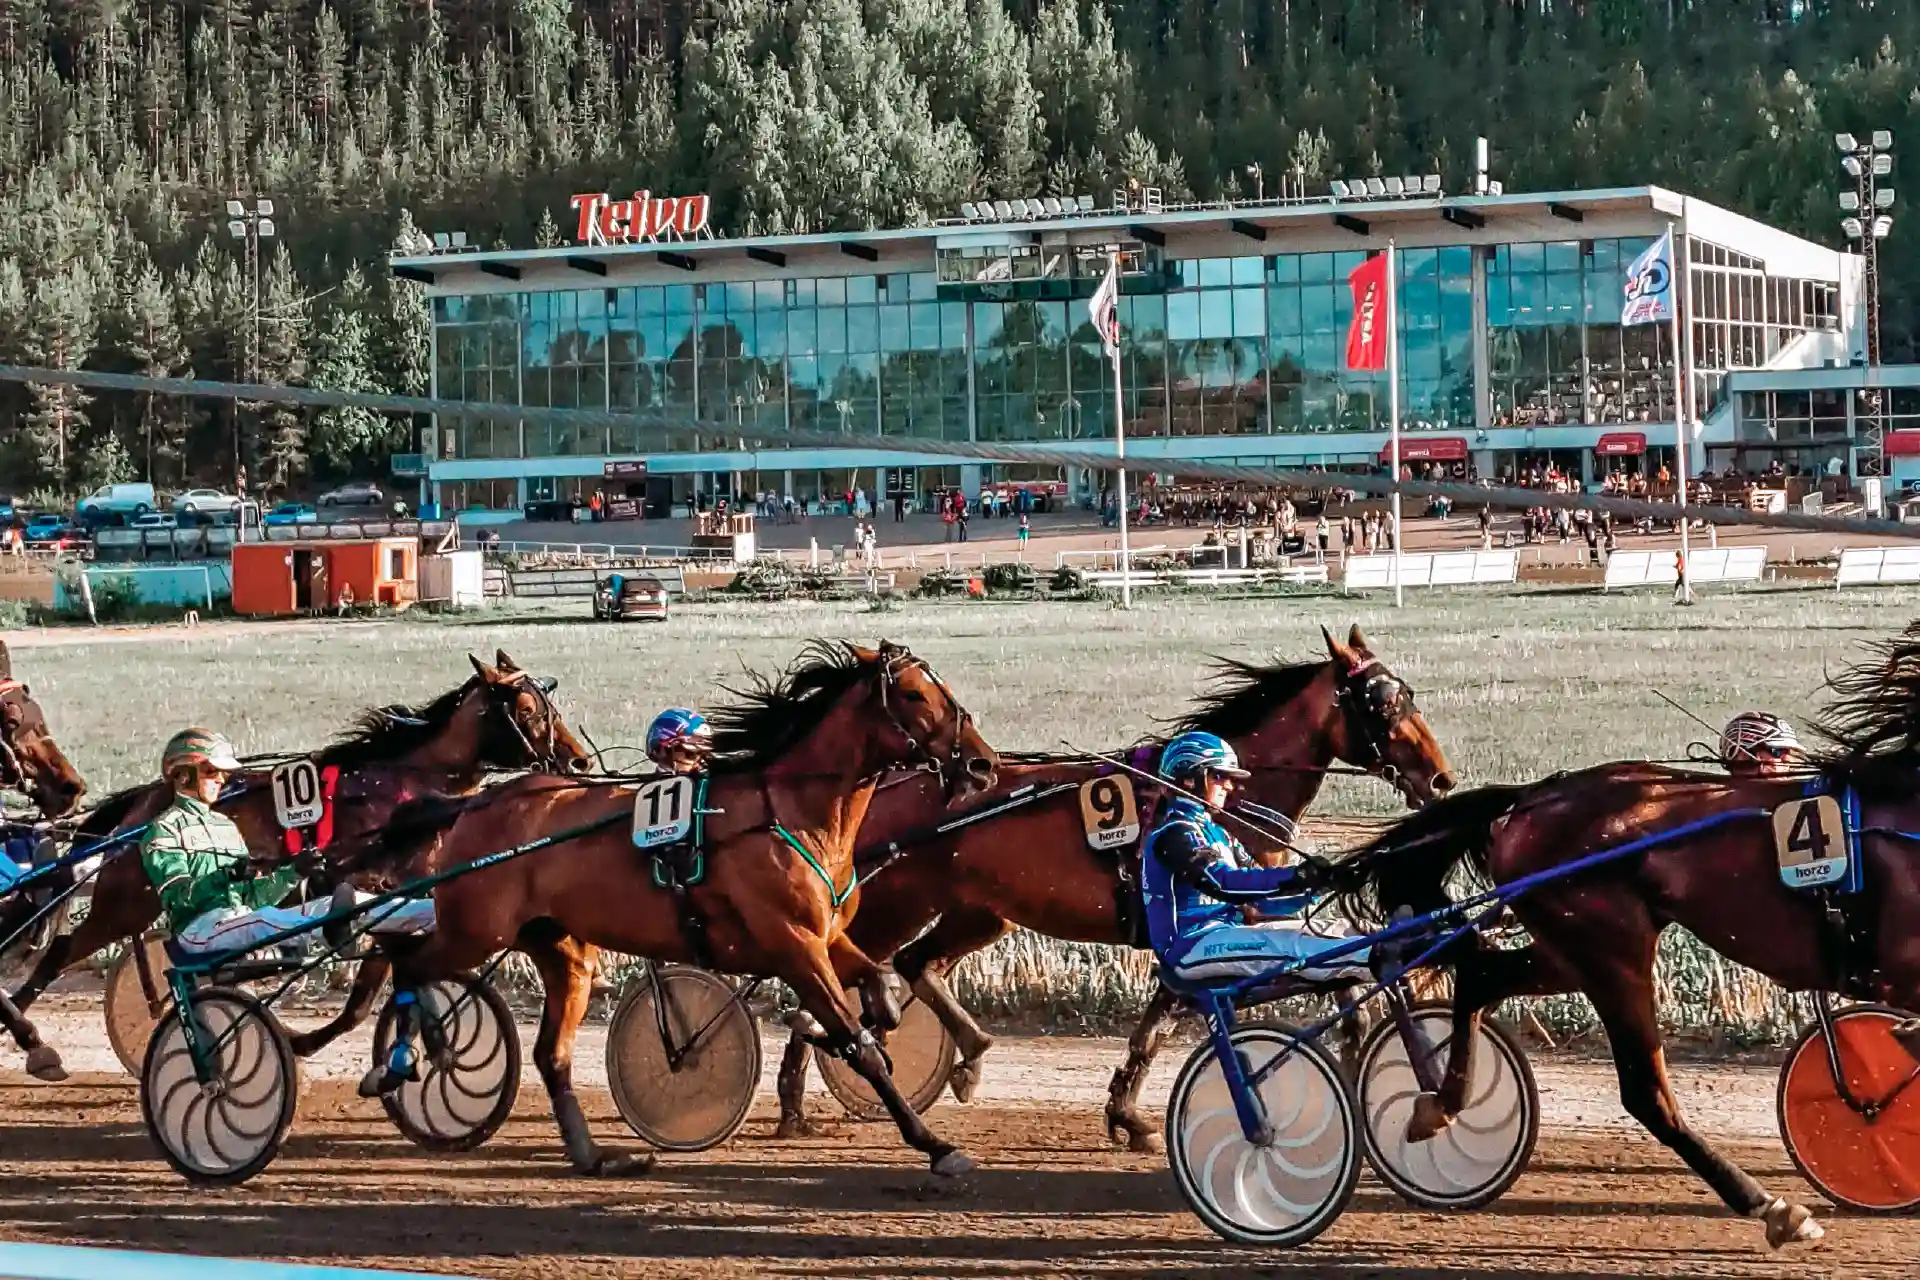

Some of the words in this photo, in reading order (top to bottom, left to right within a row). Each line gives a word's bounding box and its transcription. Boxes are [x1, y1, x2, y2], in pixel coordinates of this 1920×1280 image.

[570, 190, 710, 241] Teivo
[275, 763, 316, 808] 10
[643, 780, 682, 826] 11
[1090, 778, 1124, 829] 9
[1787, 799, 1831, 860] 4
[1795, 863, 1832, 879] horze
